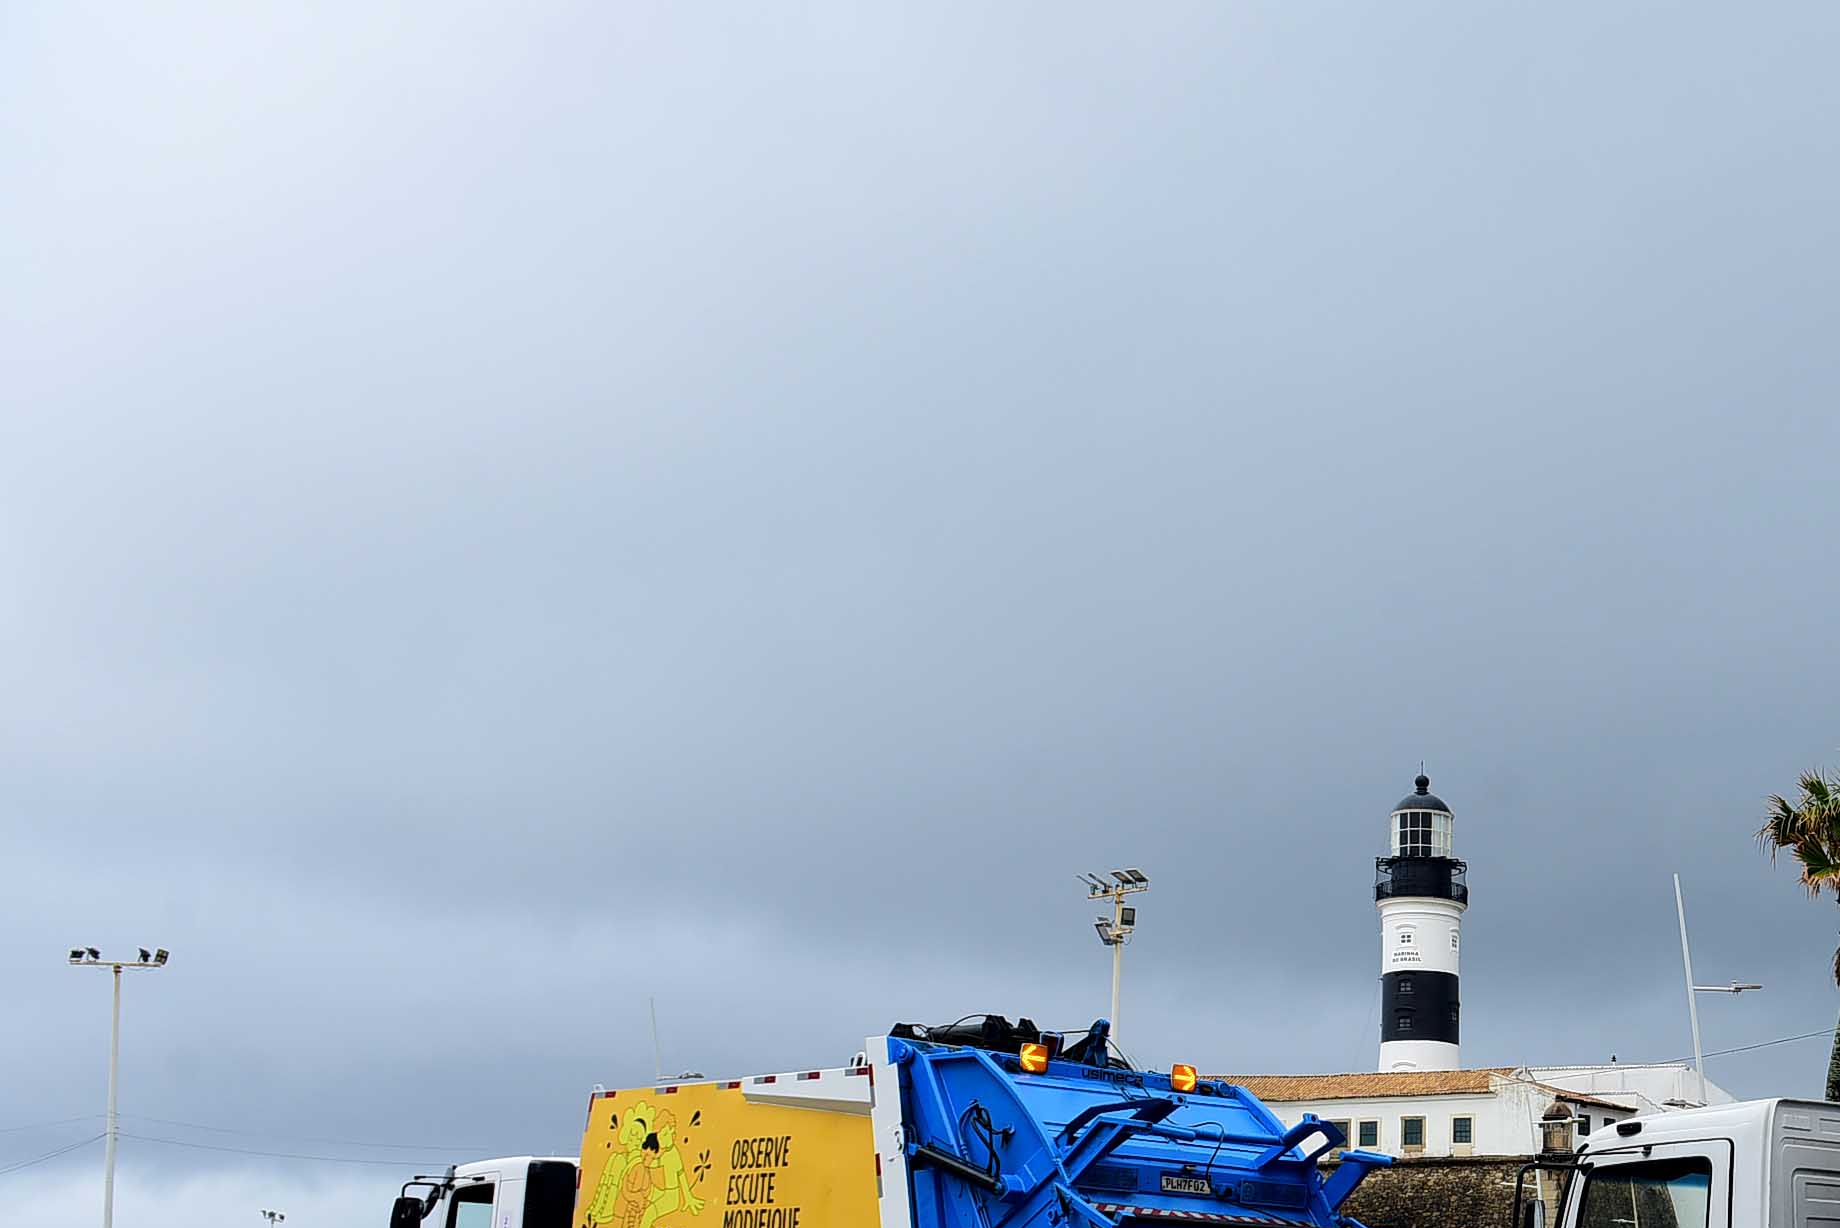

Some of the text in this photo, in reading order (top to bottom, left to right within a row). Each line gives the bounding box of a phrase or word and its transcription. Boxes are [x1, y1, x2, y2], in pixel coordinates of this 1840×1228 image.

[1081, 1068, 1144, 1086] usimeca
[731, 1135, 792, 1170] OBSERVE
[726, 1172, 776, 1205] ESCUTE
